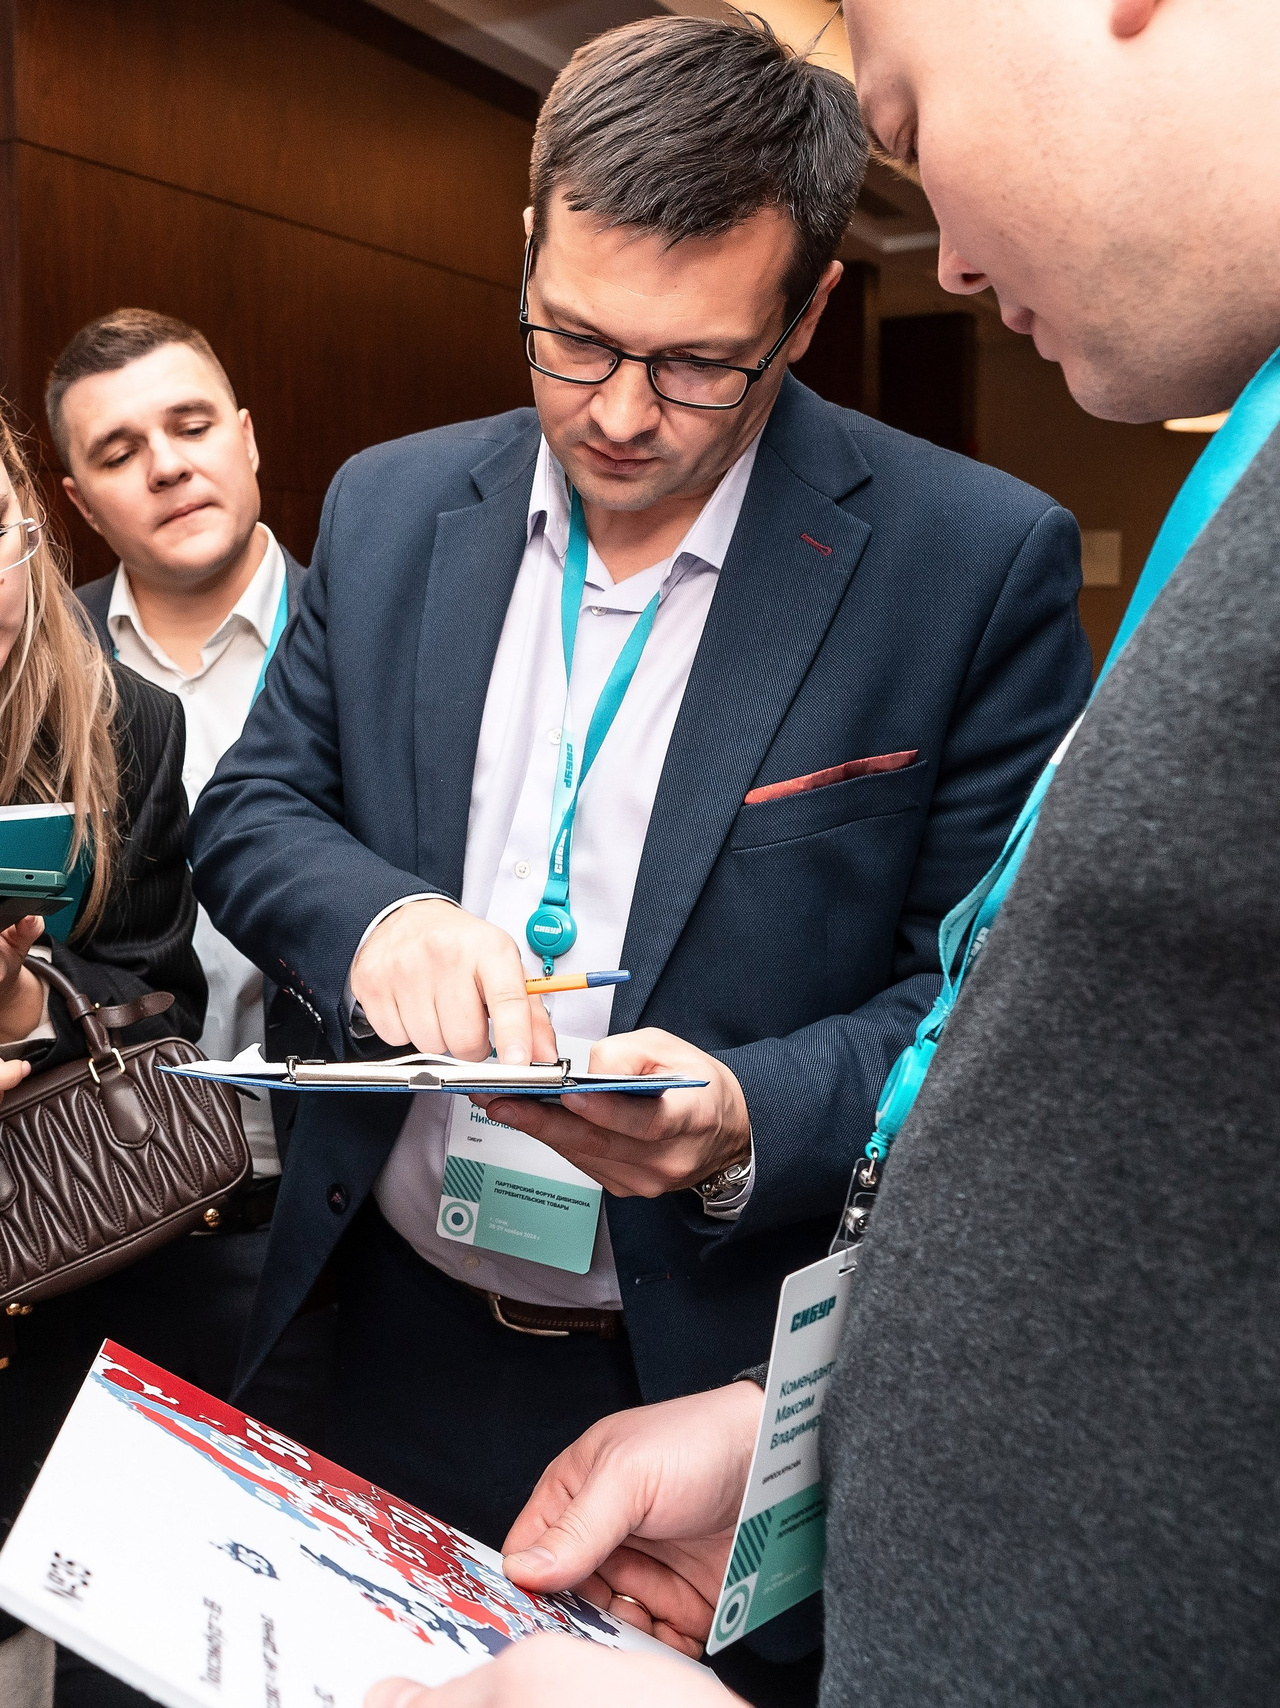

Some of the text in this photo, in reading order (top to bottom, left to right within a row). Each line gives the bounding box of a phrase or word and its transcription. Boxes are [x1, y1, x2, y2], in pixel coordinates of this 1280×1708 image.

[563, 742, 574, 789] СИБУР
[493, 1187, 569, 1211] ПОТРЕБИТЕЛЬСКИЕ ТОВАРЫ
[495, 1179, 590, 1208] ПАРТНЕРСКИЙ ФОРУМ ДИВИЗИОНА
[790, 1295, 837, 1333] СИБУР
[775, 1394, 815, 1425] Максим
[246, 1417, 311, 1469] 56
